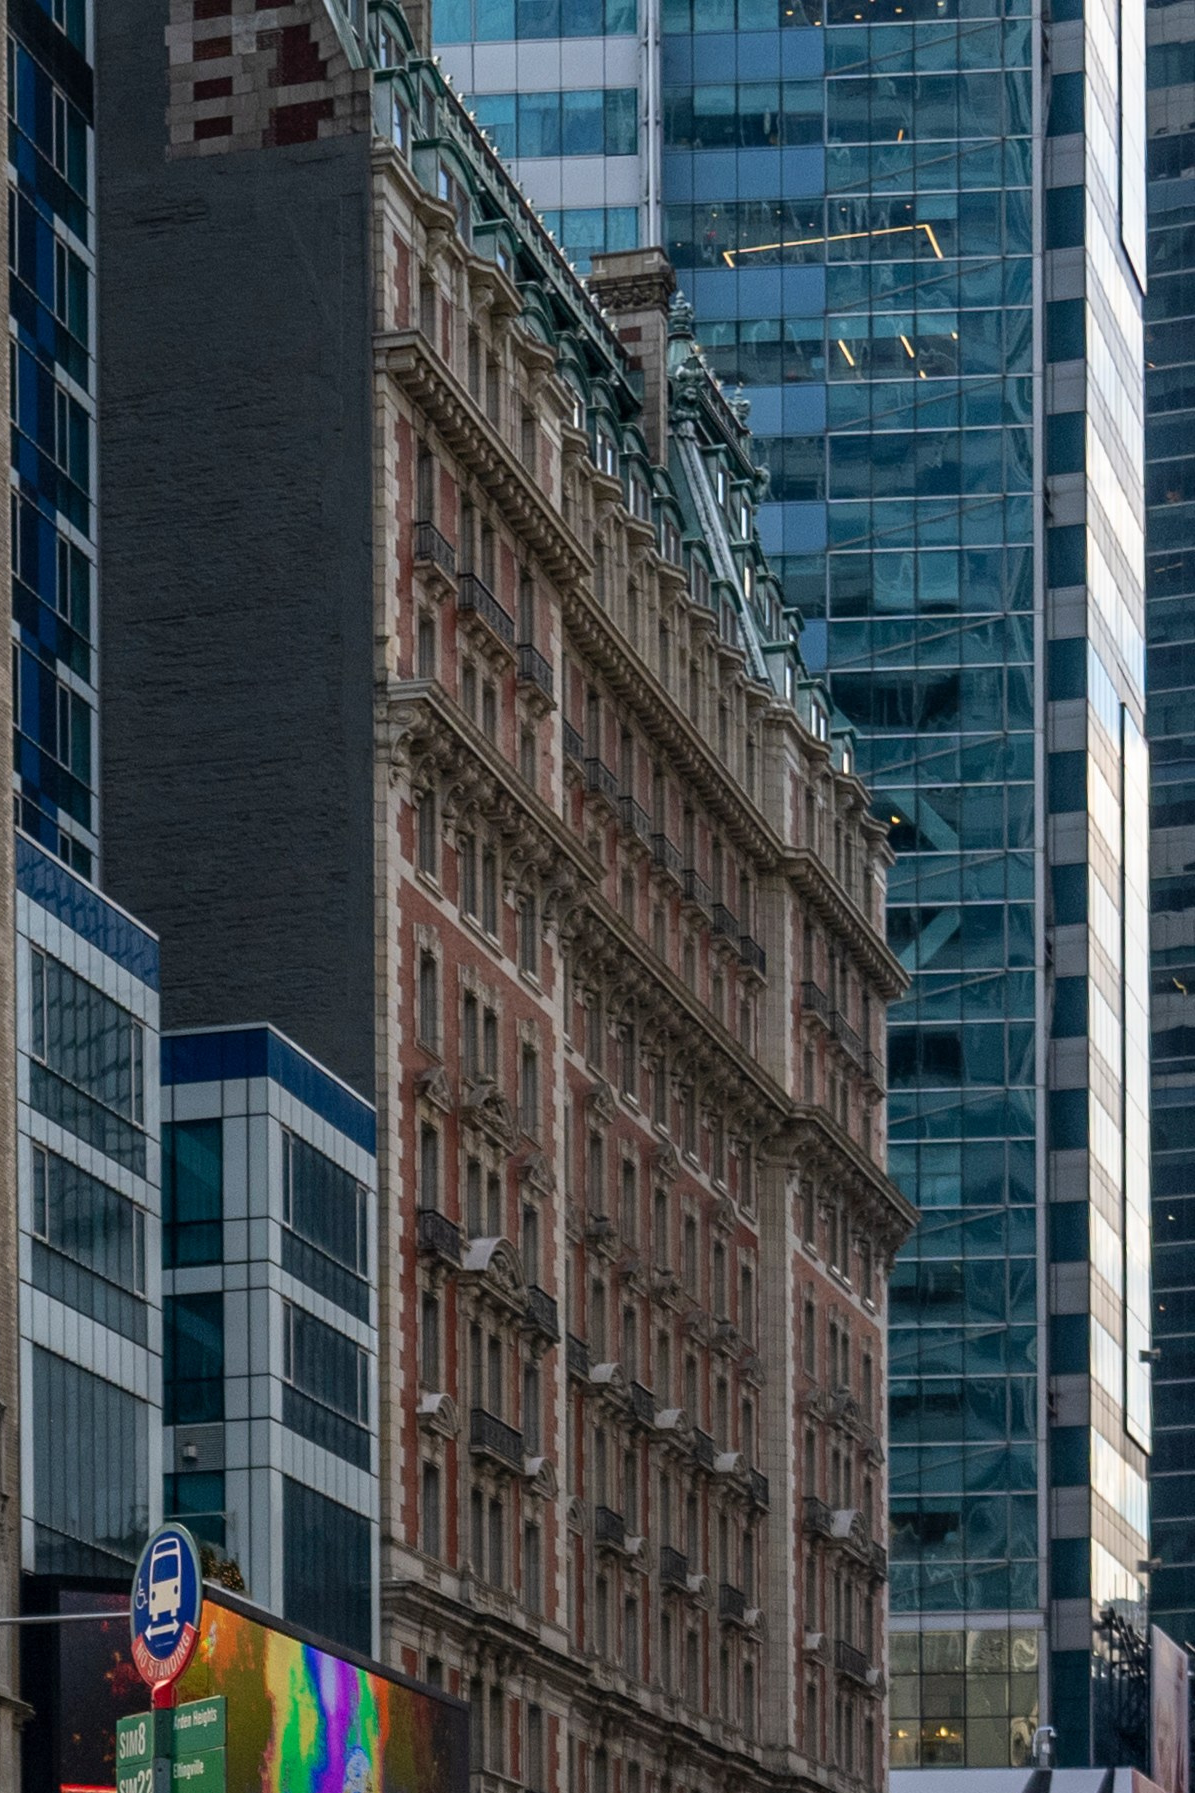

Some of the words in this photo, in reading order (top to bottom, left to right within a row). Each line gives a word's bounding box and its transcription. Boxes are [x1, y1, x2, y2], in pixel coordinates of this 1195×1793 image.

[135, 1642, 148, 1668] NO
[147, 1631, 190, 1677] STANDING
[192, 1707, 218, 1727] Heights
[119, 1722, 146, 1759] SIM8
[173, 1759, 204, 1780] Eltingville
